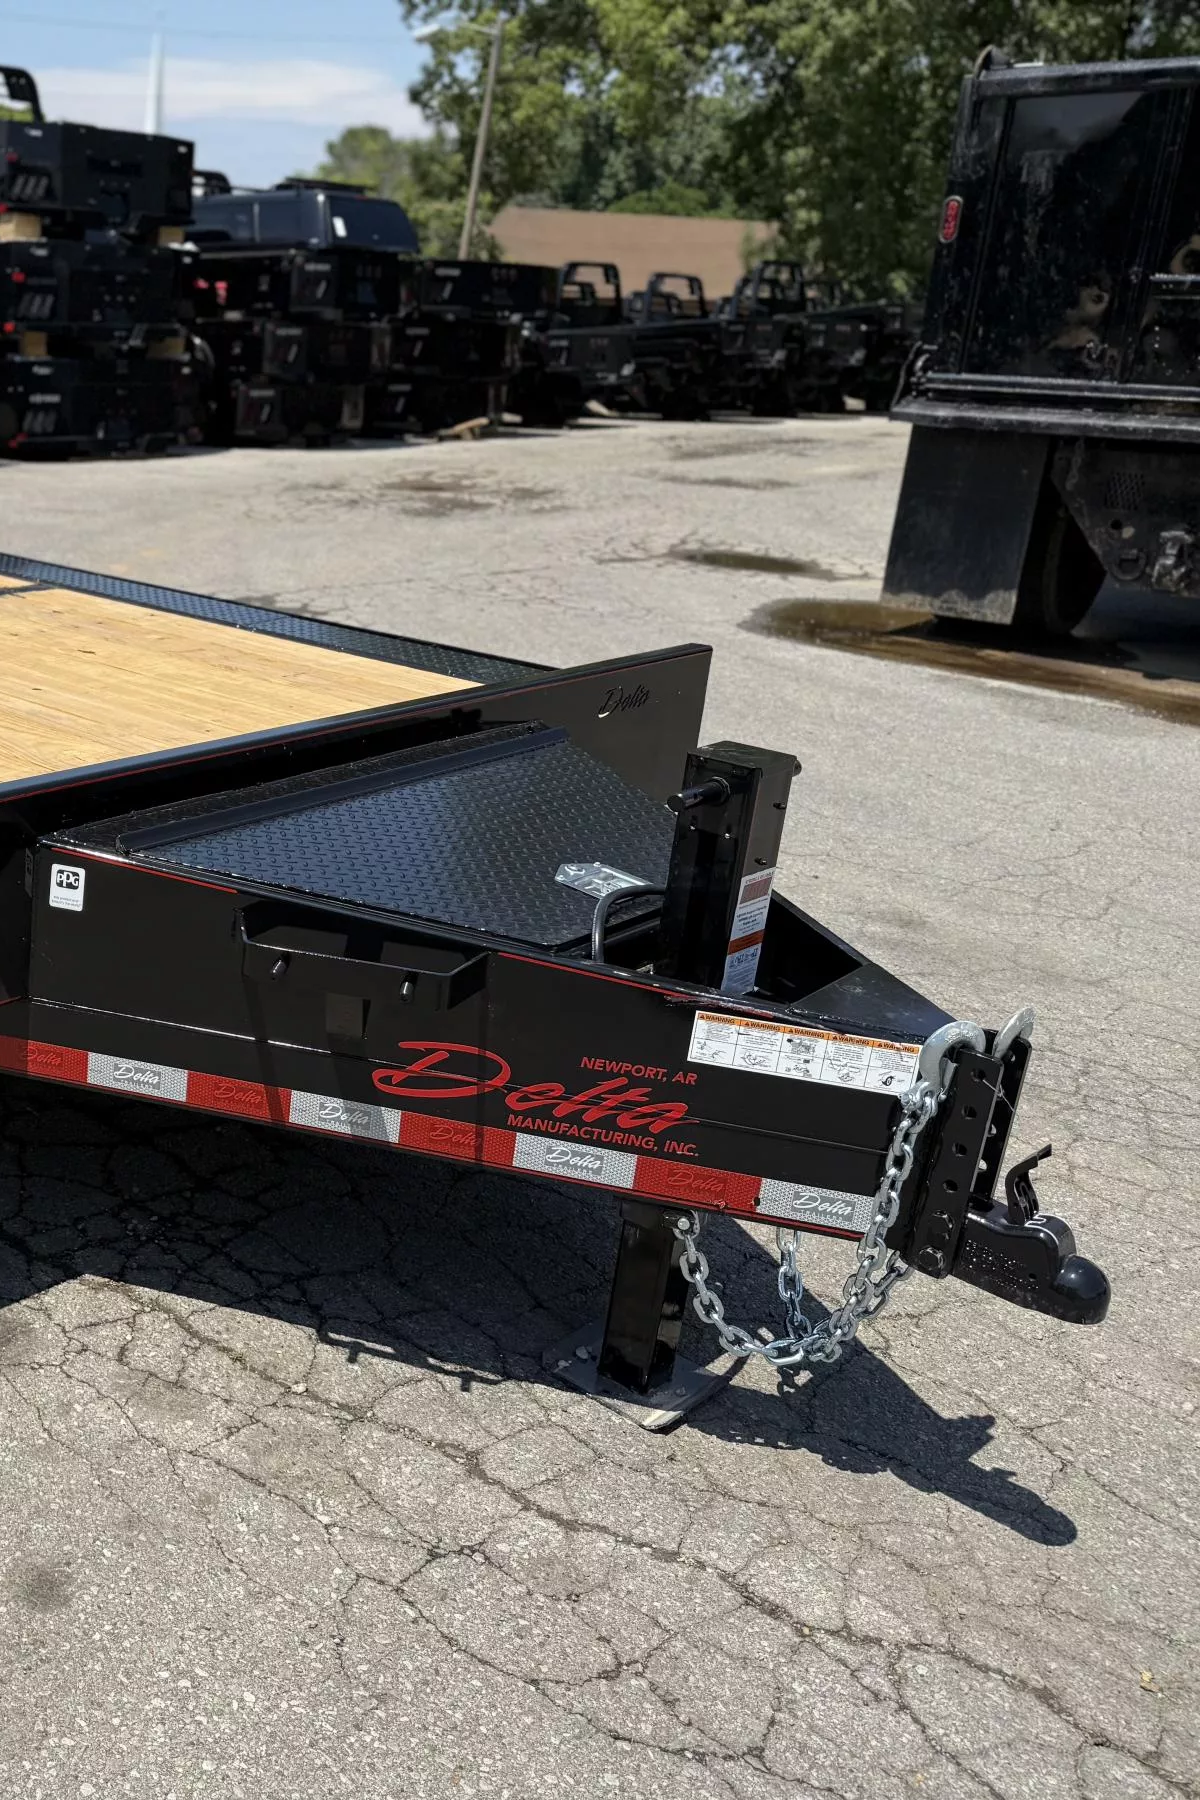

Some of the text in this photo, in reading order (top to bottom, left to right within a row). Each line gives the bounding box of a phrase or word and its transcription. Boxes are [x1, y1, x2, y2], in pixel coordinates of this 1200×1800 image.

[56, 871, 80, 888] PPG
[706, 1014, 736, 1025] WARNING
[751, 1021, 782, 1032] WARNING
[794, 1028, 825, 1039] WARNING
[113, 1064, 161, 1085] Delta
[580, 1056, 698, 1086] NEWPORT, AR
[214, 1083, 264, 1104] Delta
[372, 1041, 699, 1133] Delta
[319, 1103, 369, 1126] Delta
[507, 1114, 699, 1157] MANUFACTURING, INC.
[545, 1147, 603, 1170] Delta
[667, 1169, 725, 1193] Delta
[792, 1193, 854, 1216] Delta
